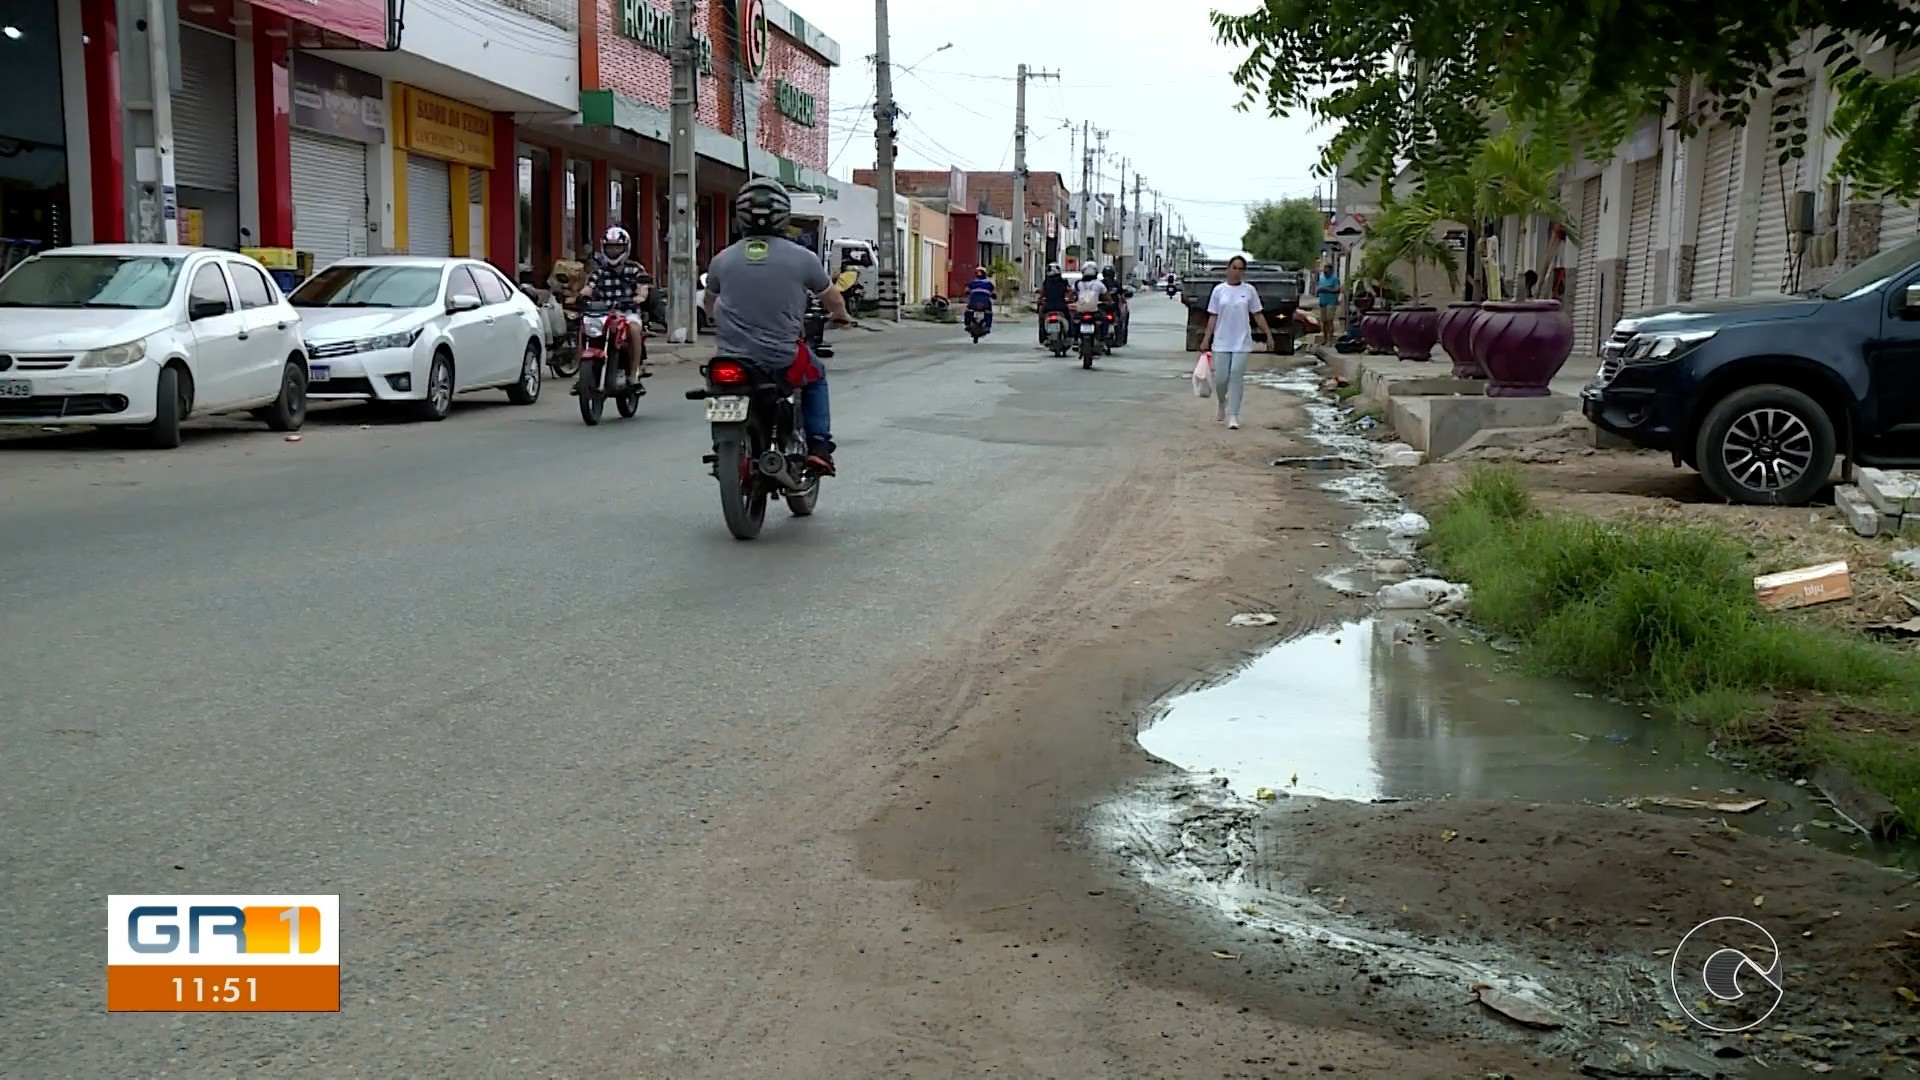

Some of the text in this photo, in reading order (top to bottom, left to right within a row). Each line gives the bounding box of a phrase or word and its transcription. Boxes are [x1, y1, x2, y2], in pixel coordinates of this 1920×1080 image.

[416, 98, 489, 136] SABOR DA TERRA
[777, 81, 816, 128] GADELHA
